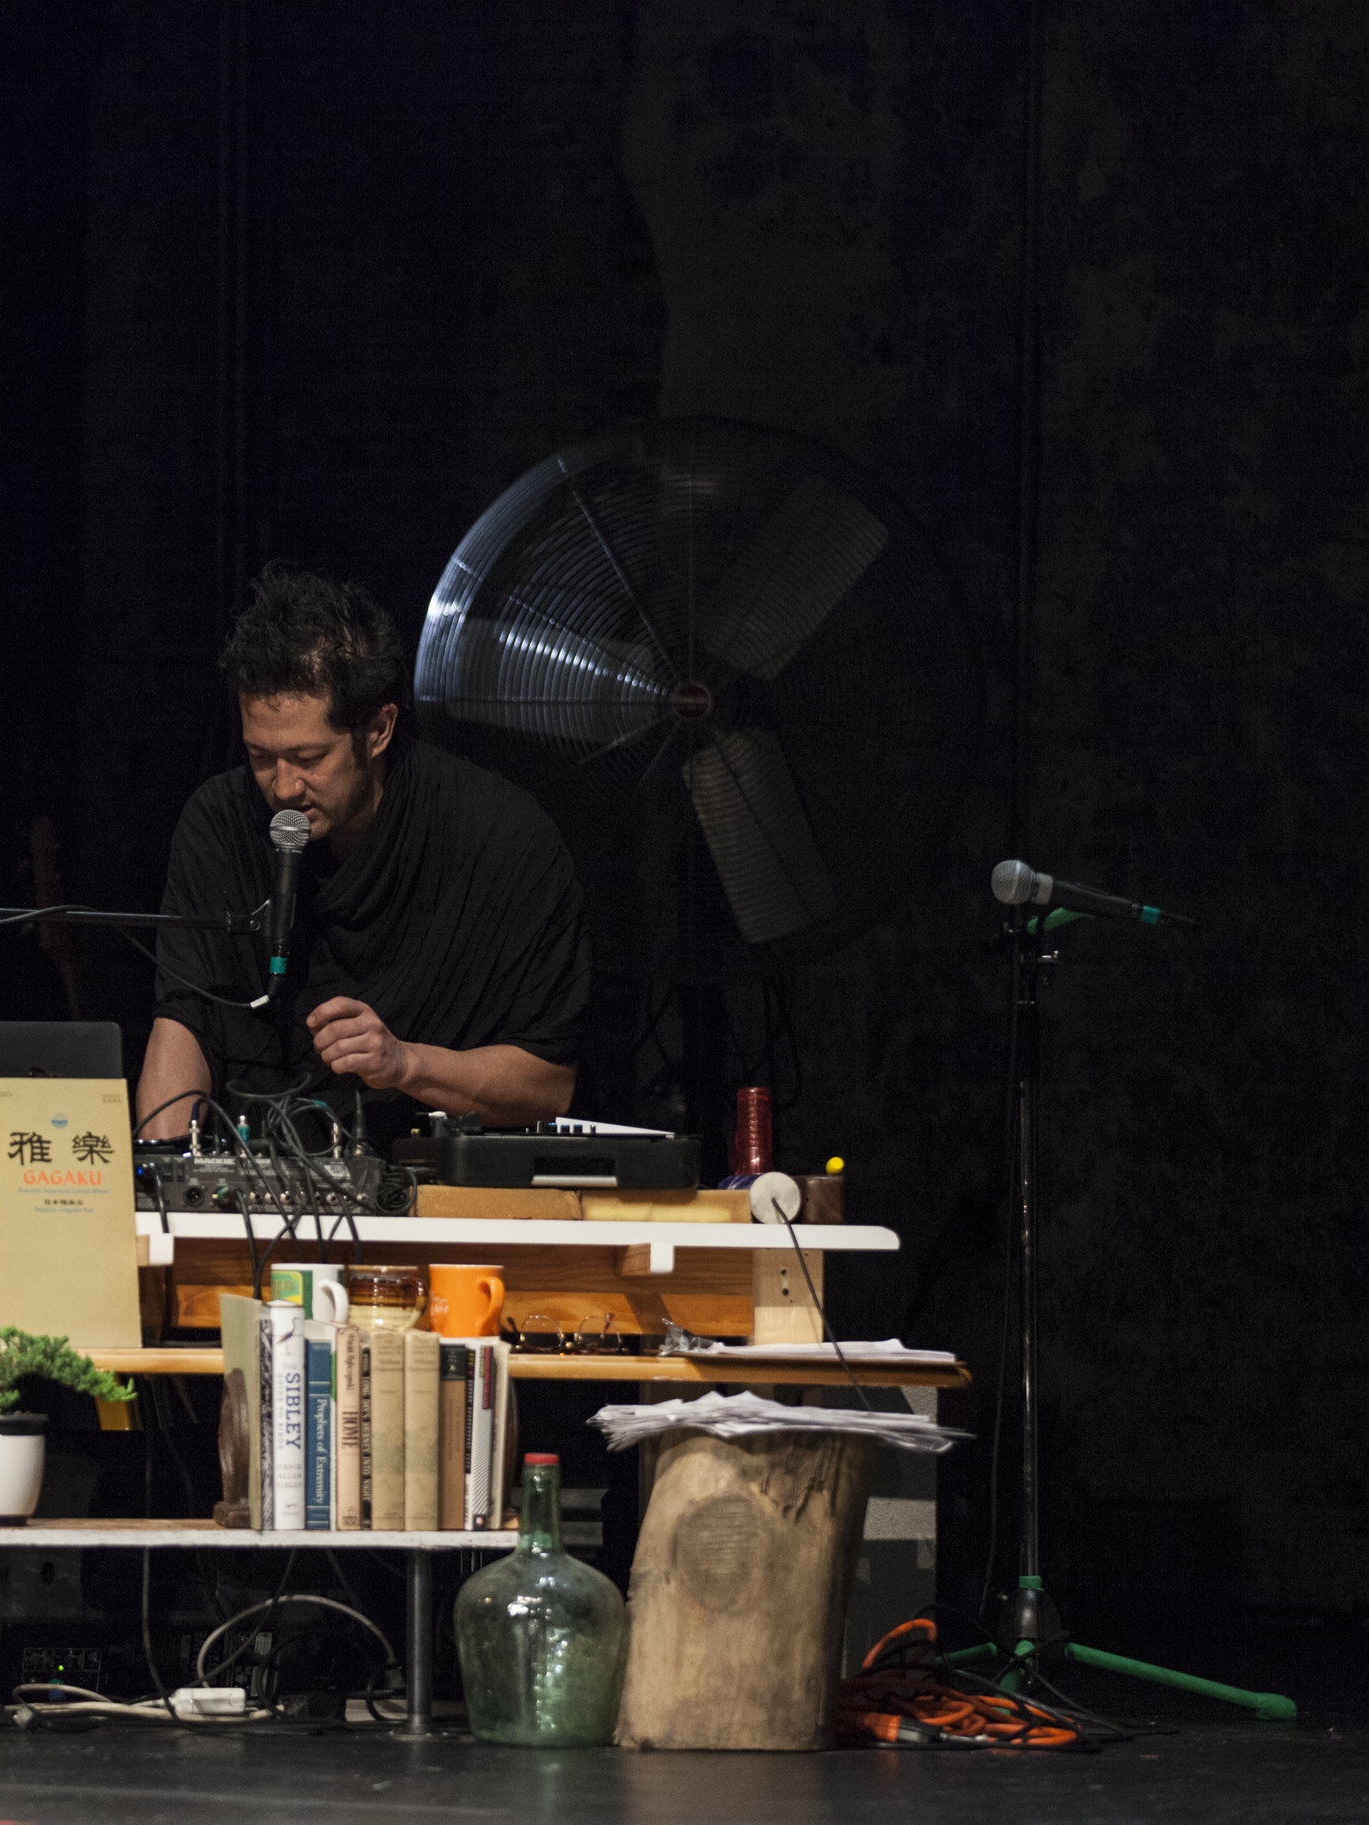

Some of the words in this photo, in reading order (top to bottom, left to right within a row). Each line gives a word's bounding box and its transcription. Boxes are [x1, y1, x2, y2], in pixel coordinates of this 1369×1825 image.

[22, 1169, 102, 1186] GAGAKU
[276, 1407, 284, 1418] TO
[285, 1372, 301, 1450] SIBLEY
[314, 1398, 328, 1440] Prophets
[341, 1411, 358, 1449] HOME
[316, 1442, 328, 1453] of
[312, 1456, 327, 1505] Extremity
